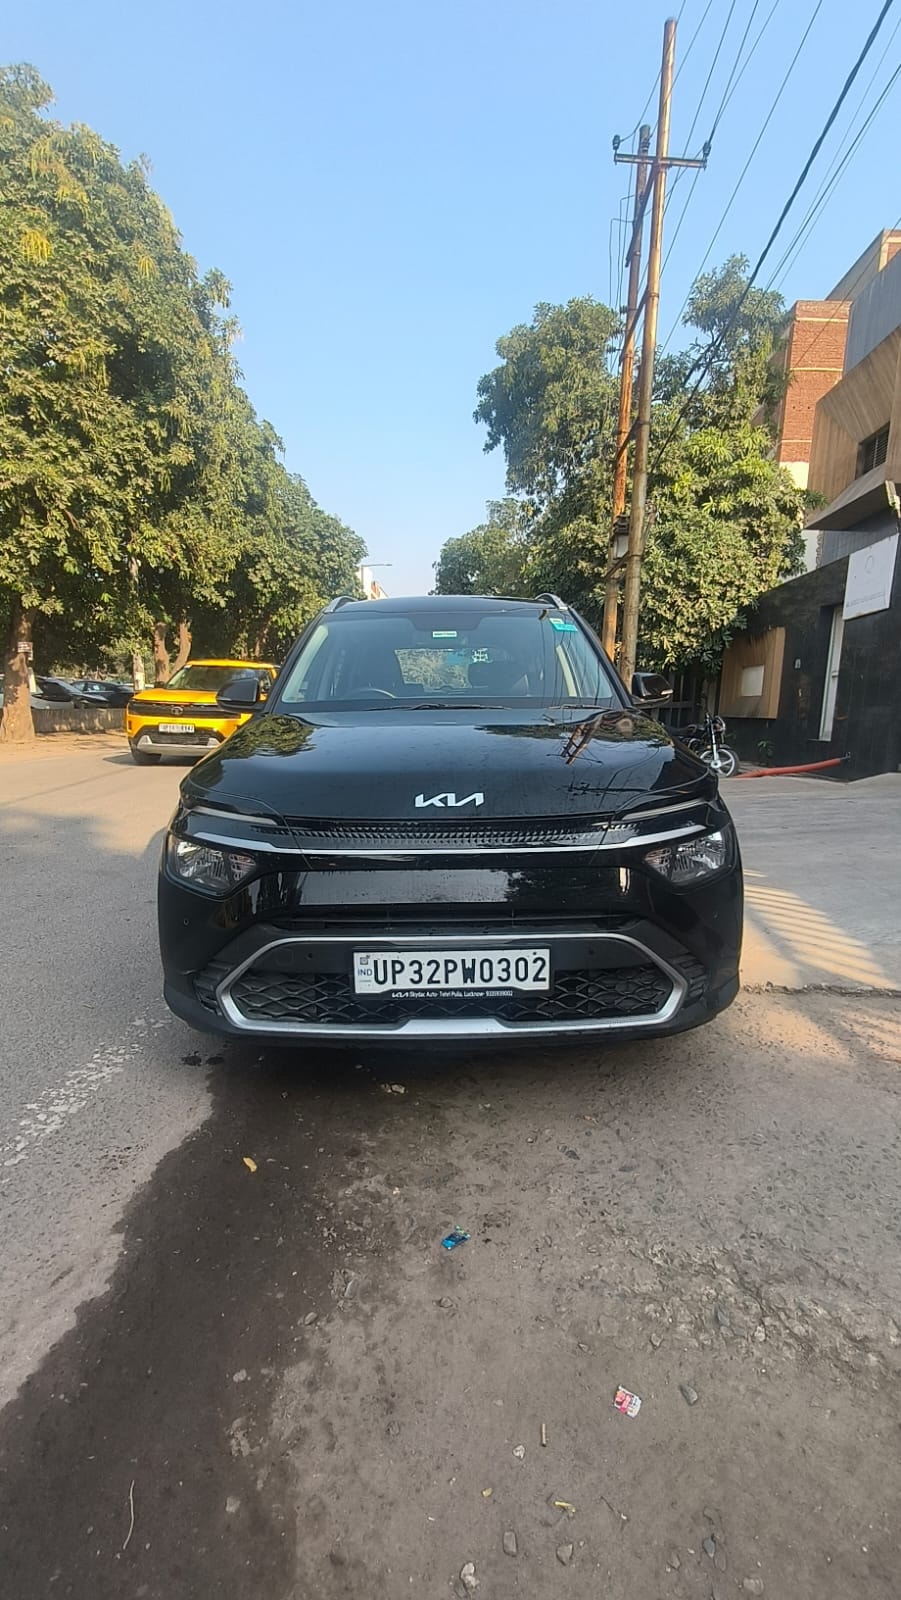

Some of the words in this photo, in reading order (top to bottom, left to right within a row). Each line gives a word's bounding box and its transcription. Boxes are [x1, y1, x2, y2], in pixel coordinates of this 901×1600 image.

[414, 792, 485, 808] KIA
[357, 968, 373, 977] IND
[373, 956, 547, 985] UP32PW0302
